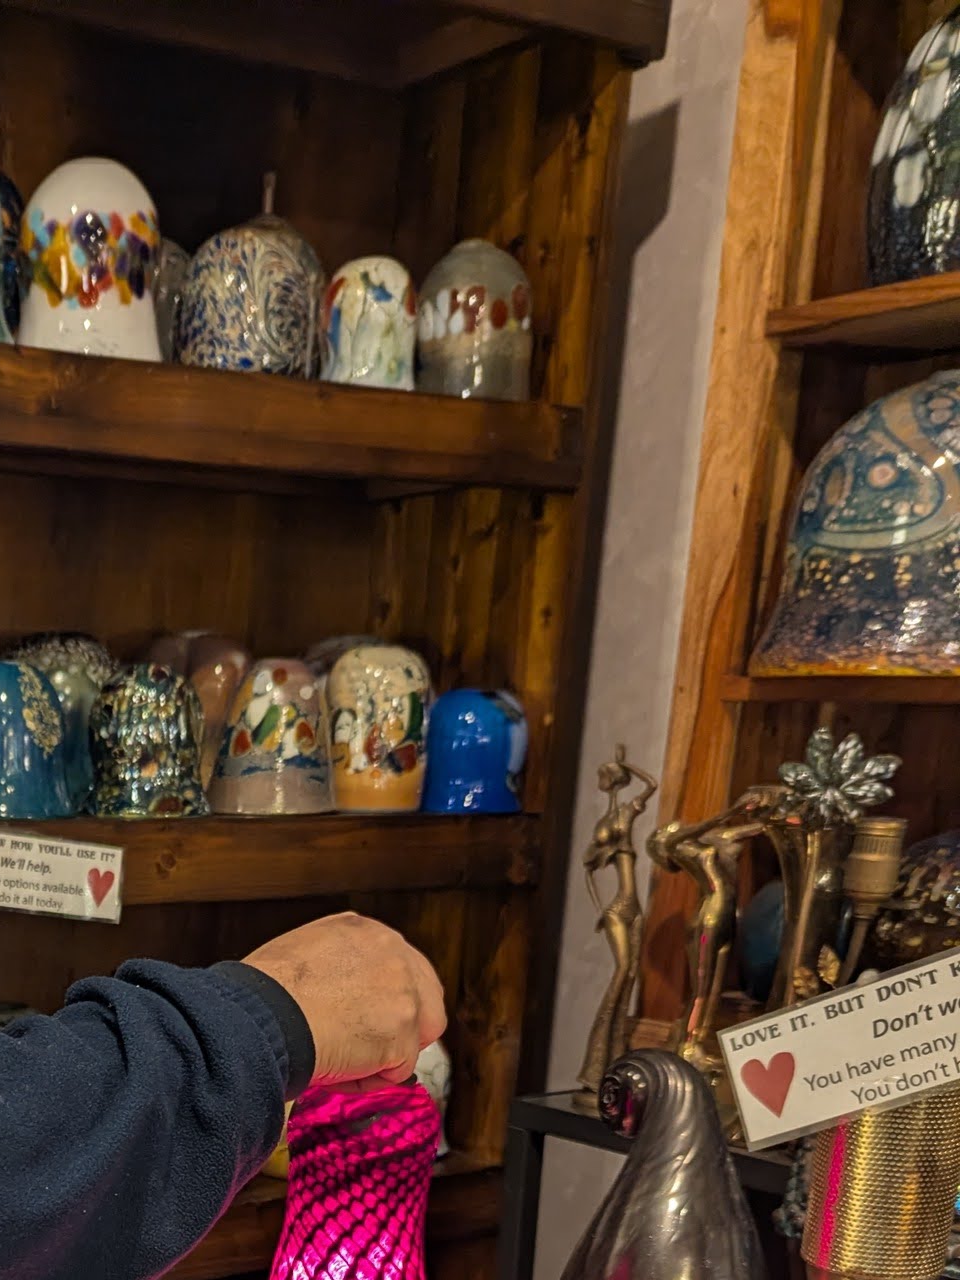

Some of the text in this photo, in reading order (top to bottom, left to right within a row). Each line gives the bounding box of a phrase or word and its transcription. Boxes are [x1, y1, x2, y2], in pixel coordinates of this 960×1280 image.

[10, 840, 33, 851] HOW
[76, 849, 96, 860] USE
[100, 852, 116, 862] IT?
[0, 857, 25, 870] We'll
[26, 860, 52, 876] help.
[3, 877, 39, 891] options
[13, 895, 20, 904] it
[22, 895, 34, 905] all
[730, 969, 937, 1052] LOVE IT. BUT DON'T
[872, 1004, 933, 1038] Don't
[803, 1032, 958, 1092] You have many
[850, 1083, 890, 1104] You
[895, 1062, 951, 1092] don't
